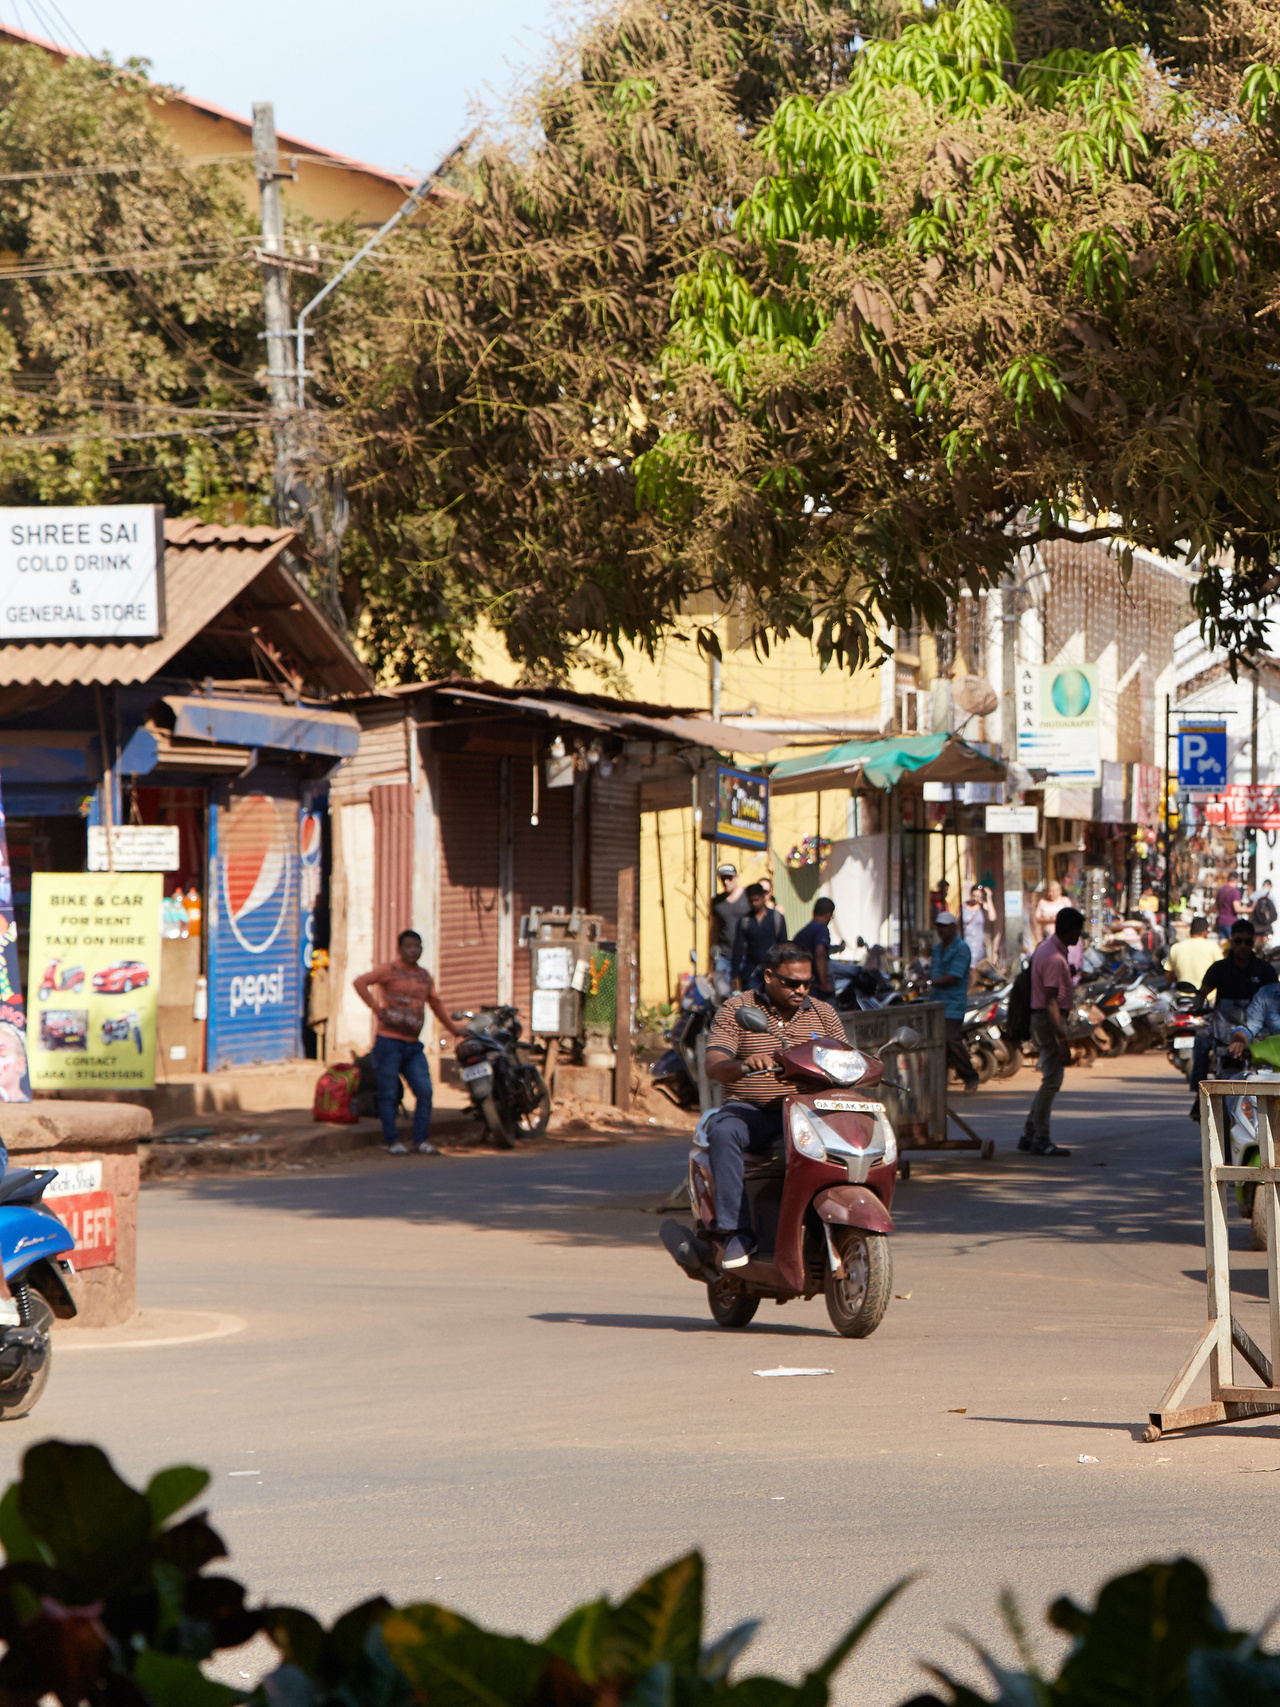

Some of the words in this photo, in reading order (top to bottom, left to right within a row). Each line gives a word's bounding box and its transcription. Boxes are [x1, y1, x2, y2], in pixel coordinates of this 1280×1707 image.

[11, 523, 91, 545] SHREE
[100, 523, 137, 543] SAI
[17, 555, 68, 572] COLD
[74, 554, 132, 571] DRINK
[69, 578, 81, 595] &
[6, 605, 86, 623] GENERAL
[91, 603, 147, 621] STORE
[1023, 669, 1033, 727] AURA
[1182, 735, 1208, 770] P
[50, 895, 88, 906] BIKE
[94, 896, 104, 906] &
[111, 895, 144, 906] CAR
[60, 917, 89, 925] FOR
[94, 917, 132, 925] RENT
[45, 936, 78, 945] TAXI
[83, 936, 104, 945] ON
[109, 936, 146, 946] HIRE
[230, 965, 284, 1017] pepsi
[65, 1057, 117, 1066] CONTACT
[73, 1206, 113, 1250] LEFT
